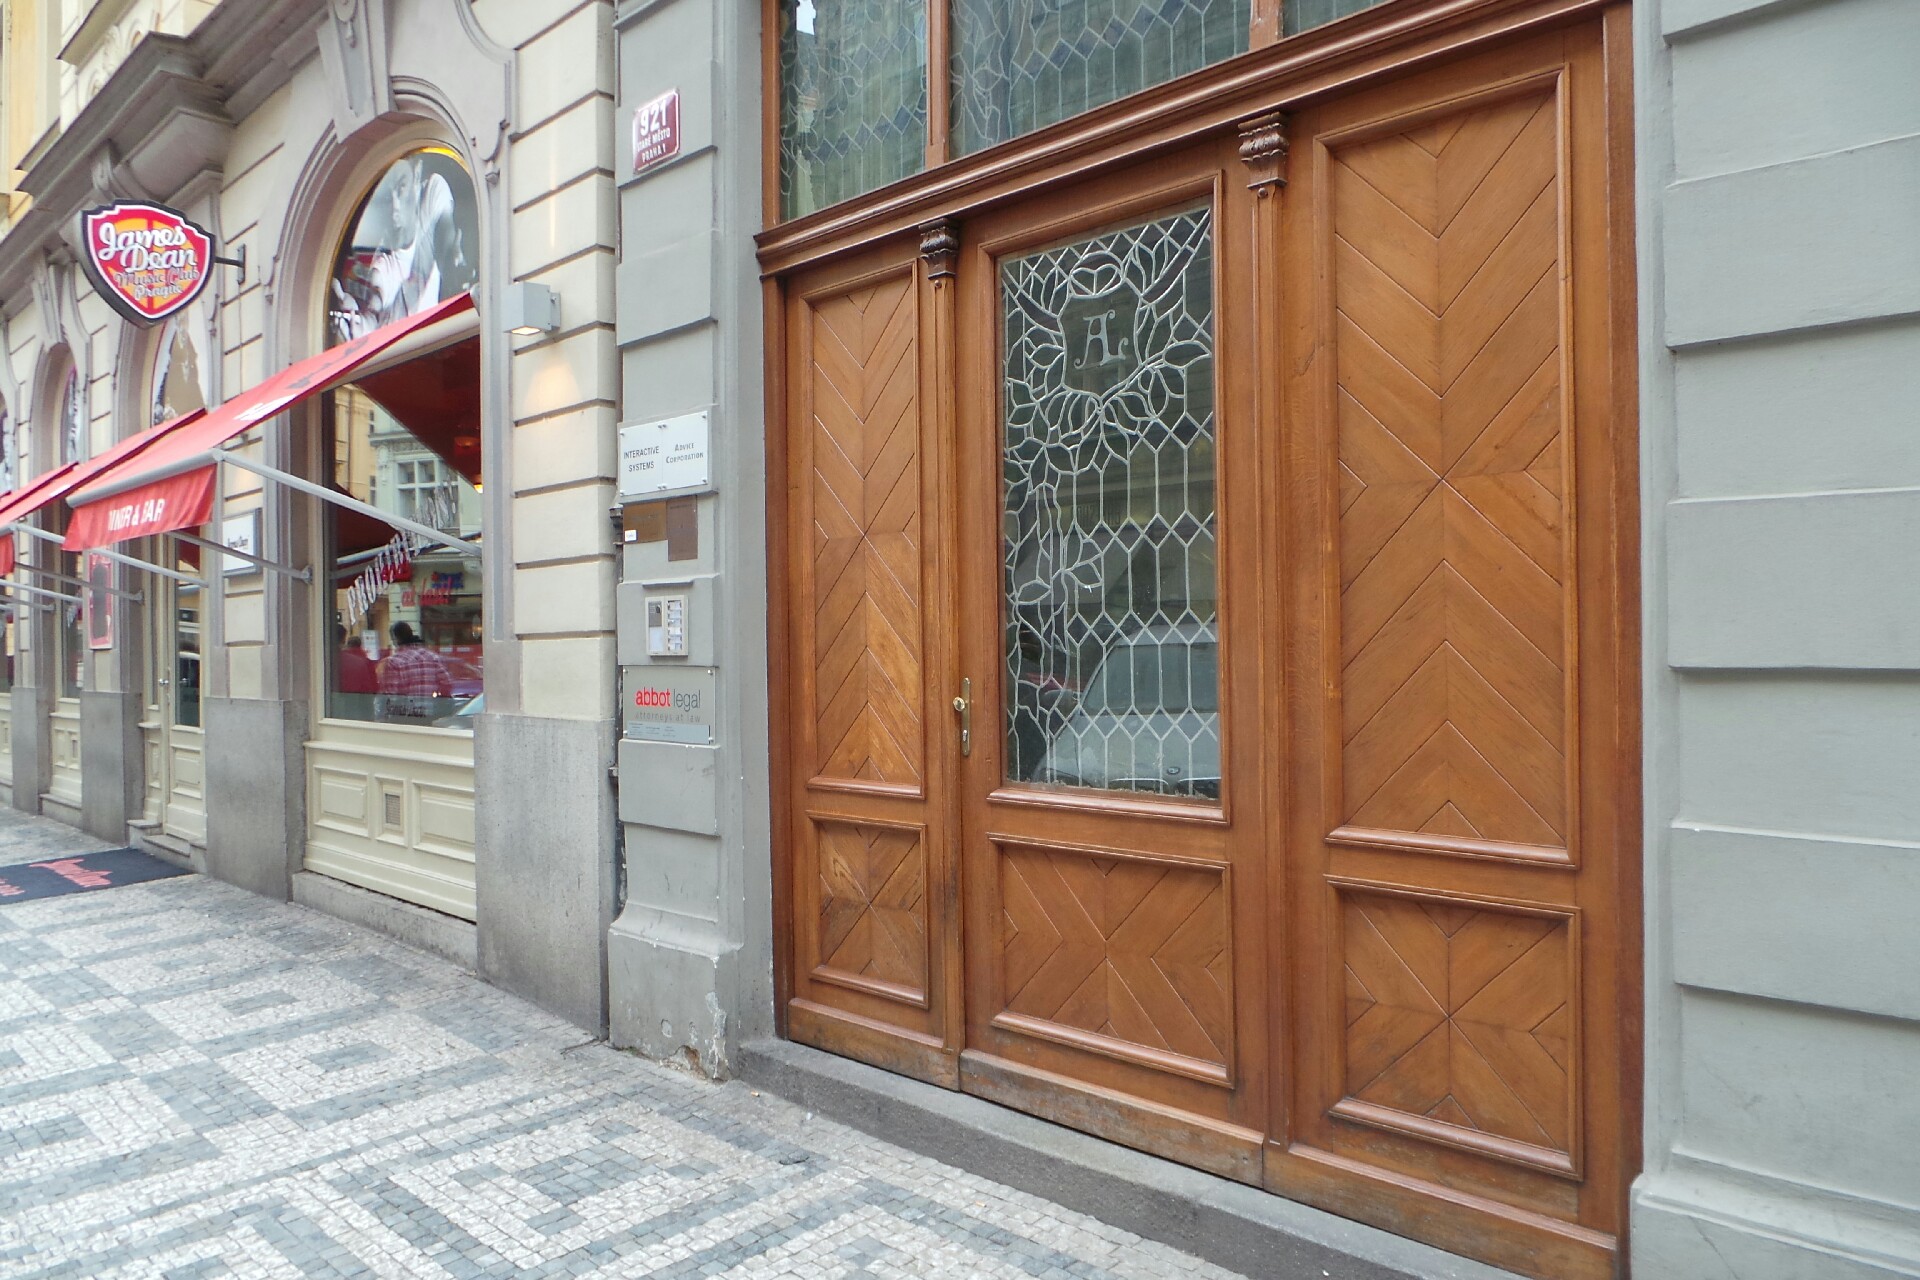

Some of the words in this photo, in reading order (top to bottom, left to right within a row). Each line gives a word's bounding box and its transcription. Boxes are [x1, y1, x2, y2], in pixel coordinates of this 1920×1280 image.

[640, 98, 667, 136] 921
[642, 144, 662, 163] PRAHA
[98, 222, 187, 261] James
[120, 243, 197, 273] Dean
[623, 445, 660, 460] INTERACTIVE
[628, 460, 655, 473] SYSTEMS
[635, 686, 671, 707] abbot
[673, 688, 701, 713] legal
[635, 711, 673, 723] attorneys
